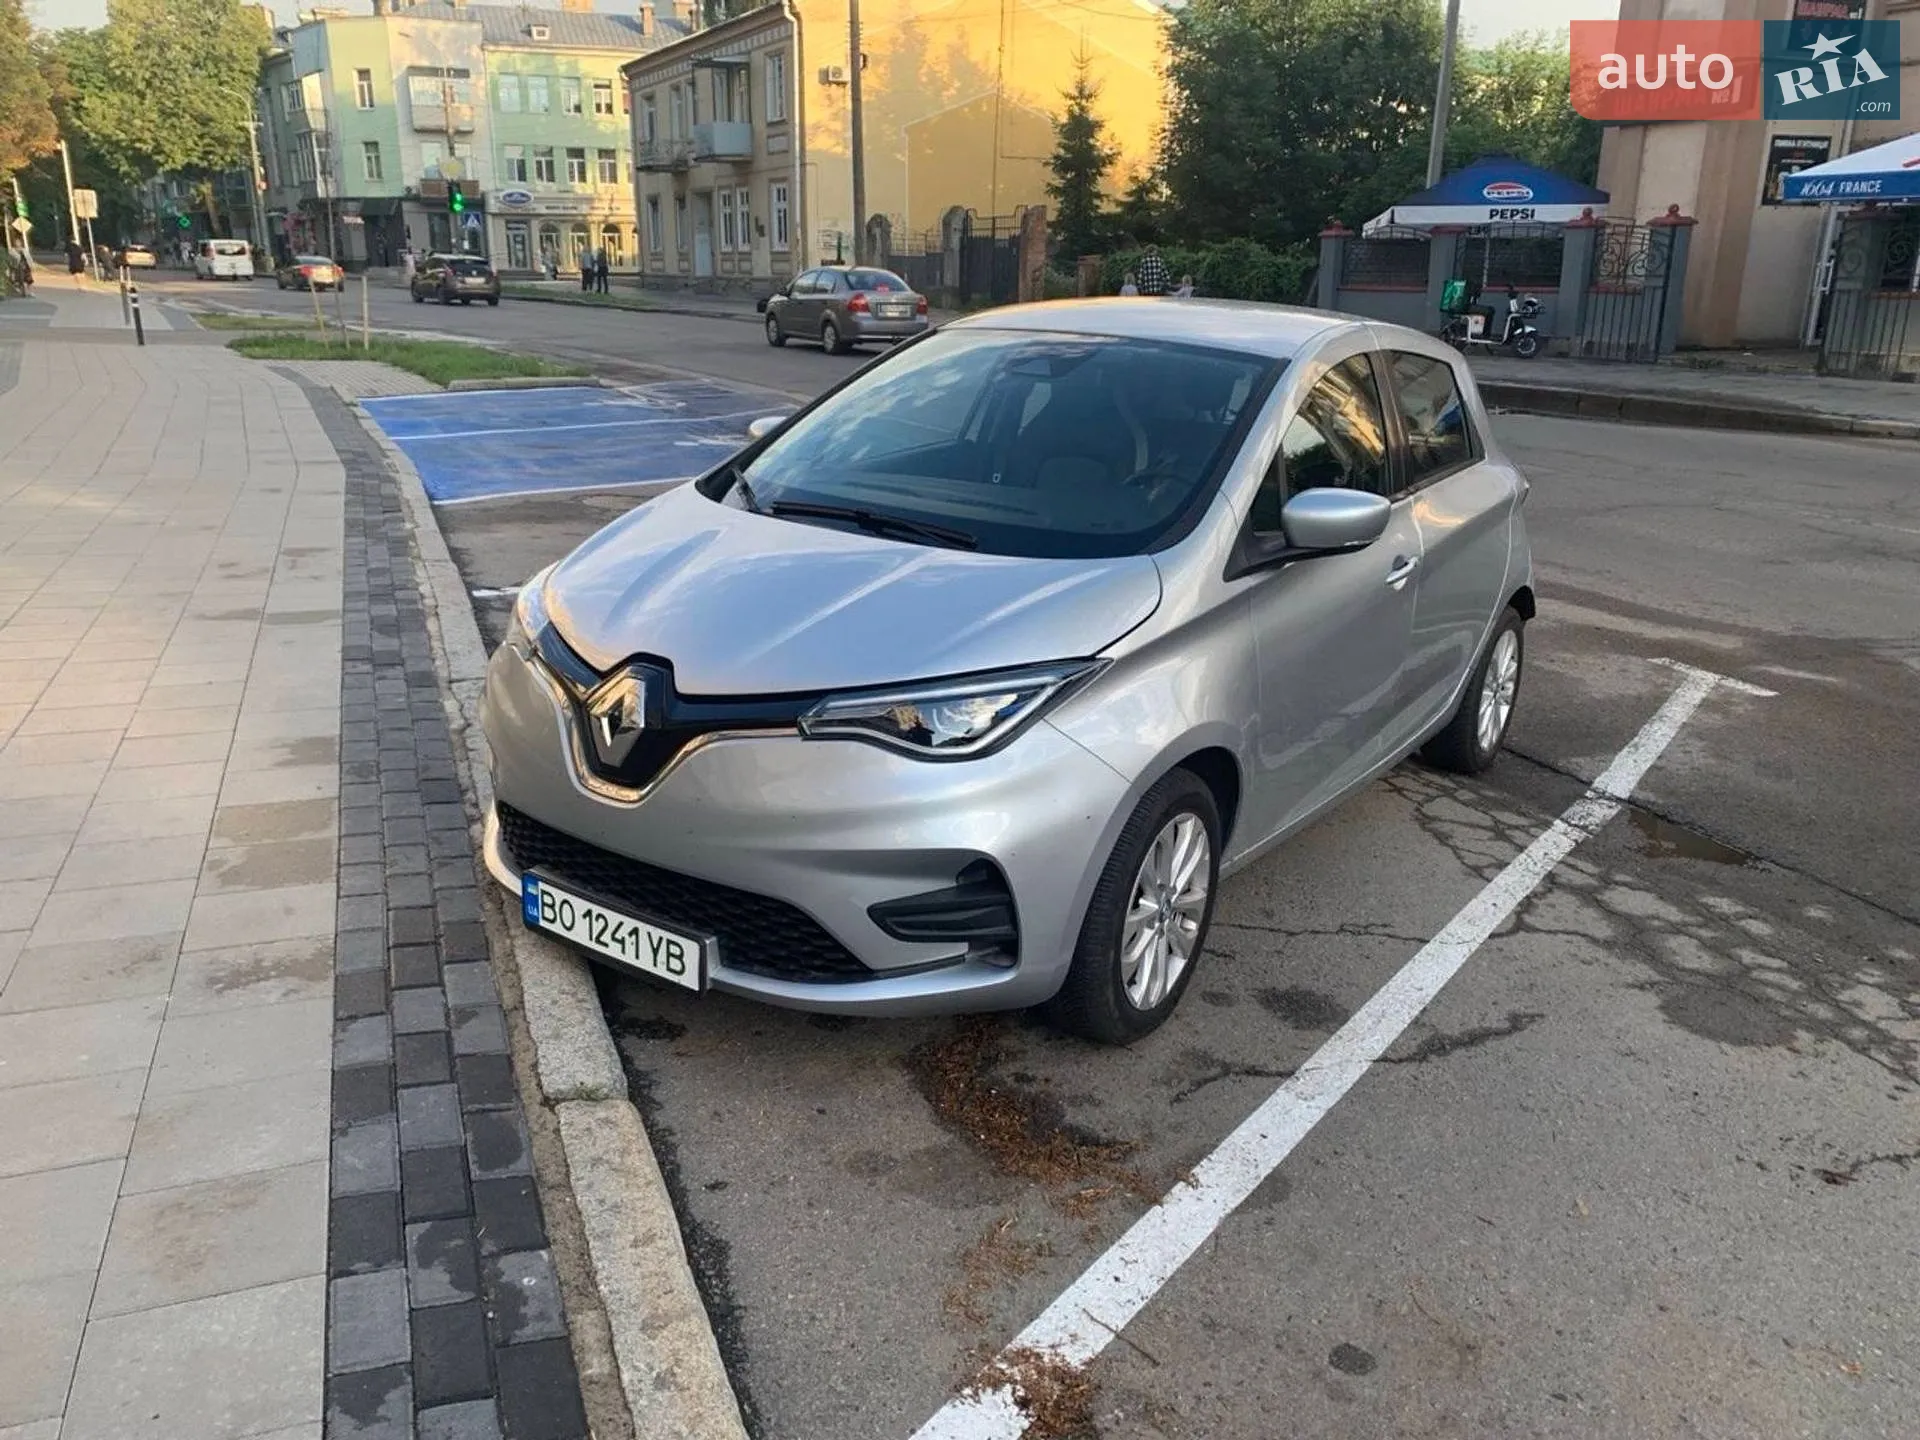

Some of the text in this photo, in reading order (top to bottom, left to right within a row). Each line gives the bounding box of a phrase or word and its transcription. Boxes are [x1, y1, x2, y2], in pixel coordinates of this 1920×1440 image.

[1839, 180, 1882, 193] FRANCE
[1489, 208, 1536, 220] PEPSI
[527, 905, 538, 917] UA
[540, 888, 686, 977] BO 1241 YB
